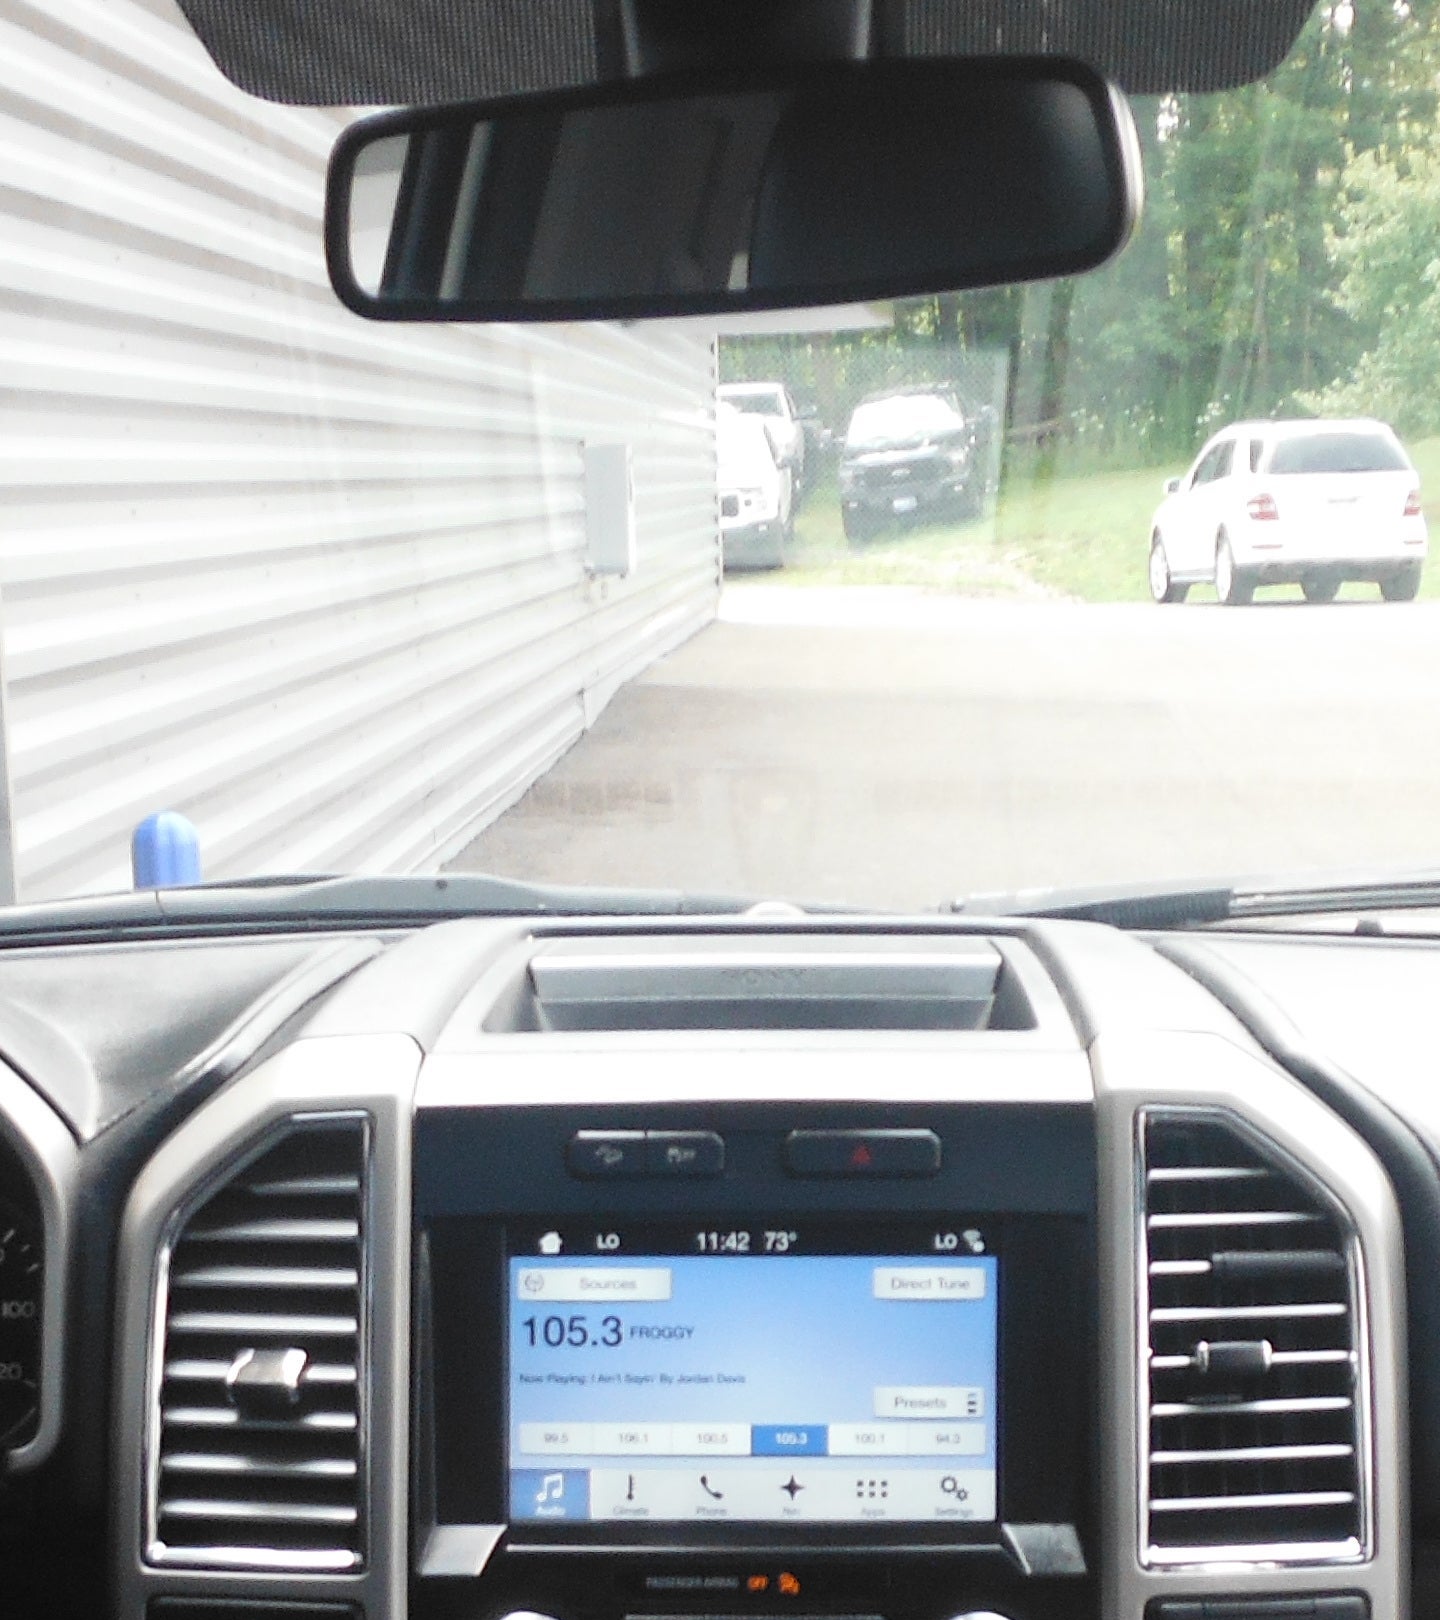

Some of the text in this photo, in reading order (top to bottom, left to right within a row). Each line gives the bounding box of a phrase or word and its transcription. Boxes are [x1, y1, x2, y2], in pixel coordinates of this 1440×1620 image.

[595, 1232, 621, 1250] LO
[696, 1230, 798, 1252] 11:42 73°
[934, 1232, 958, 1250] LO
[578, 1276, 638, 1291] Sources
[890, 1276, 971, 1291] Direct Tune
[1, 1300, 35, 1319] 100
[521, 1314, 696, 1348] 105.3 FROGGY
[893, 1396, 947, 1409] Presets
